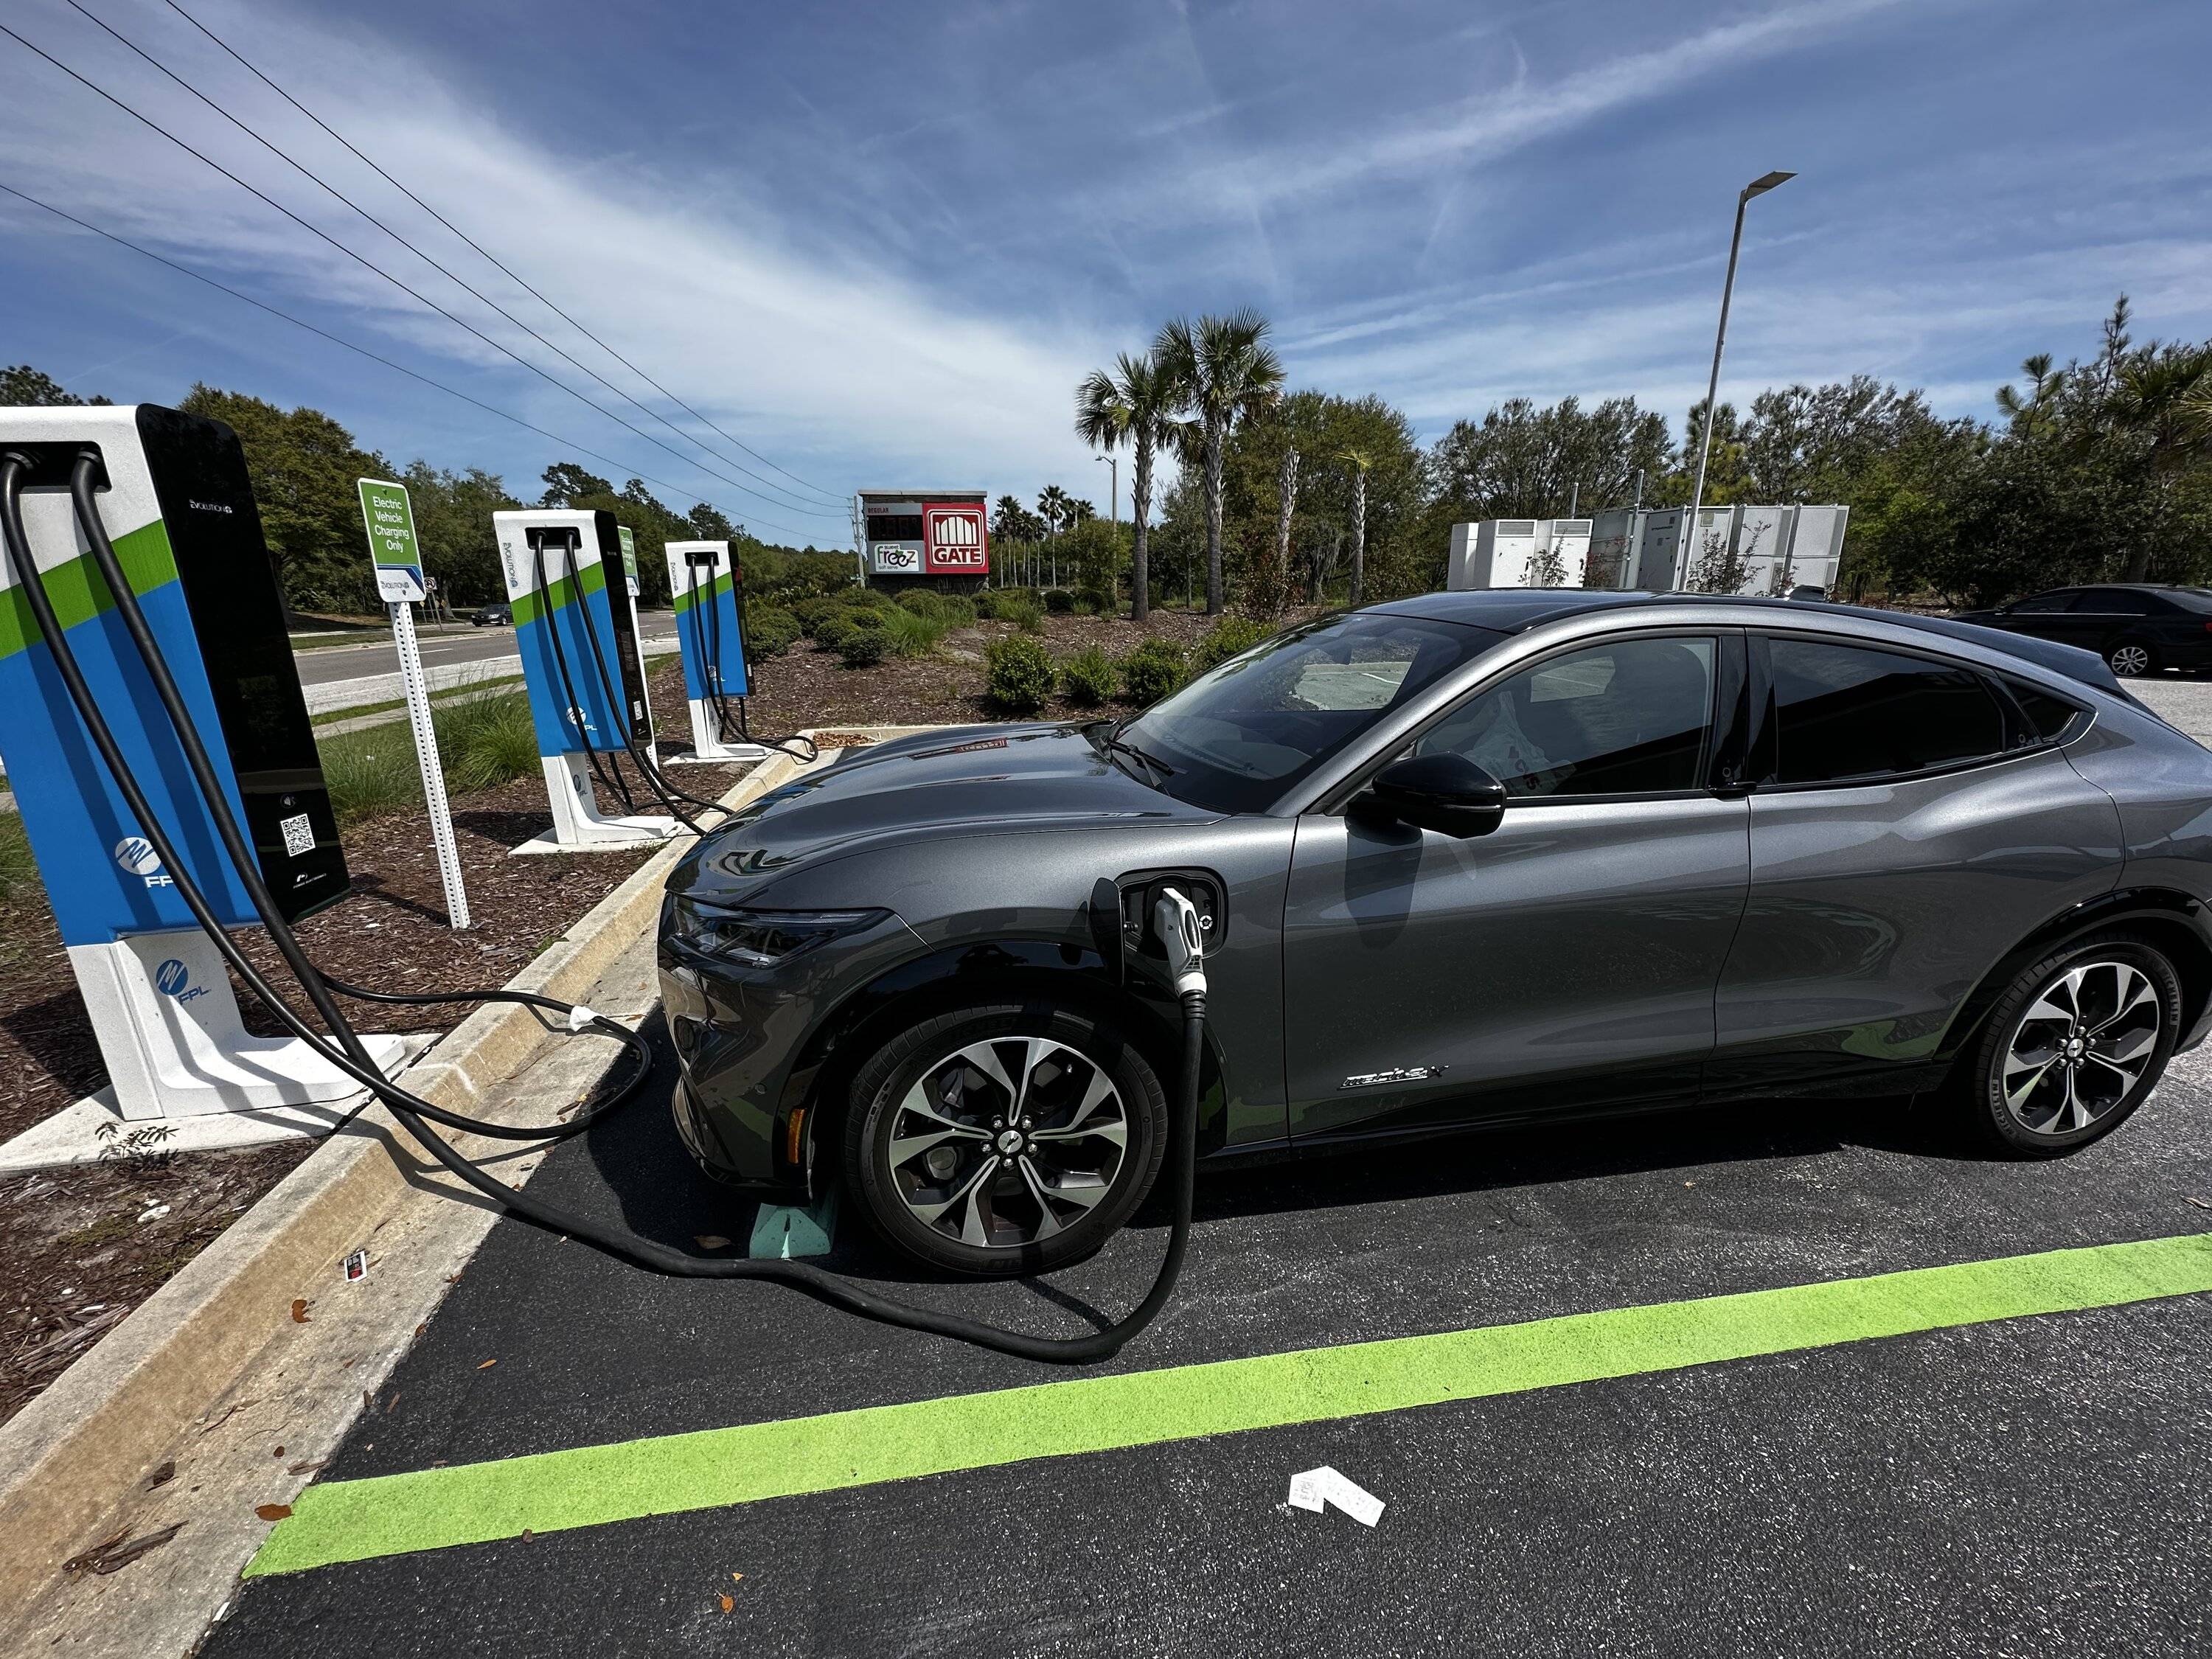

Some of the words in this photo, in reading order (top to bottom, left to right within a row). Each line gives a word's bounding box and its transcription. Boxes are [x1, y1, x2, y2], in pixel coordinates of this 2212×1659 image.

[372, 495, 403, 509] Electric
[375, 510, 403, 524] Vehicle
[375, 524, 410, 540] Charging
[386, 540, 403, 553] Only
[934, 547, 981, 563] GATE
[145, 875, 174, 888] FP
[178, 986, 212, 1006] FPL
